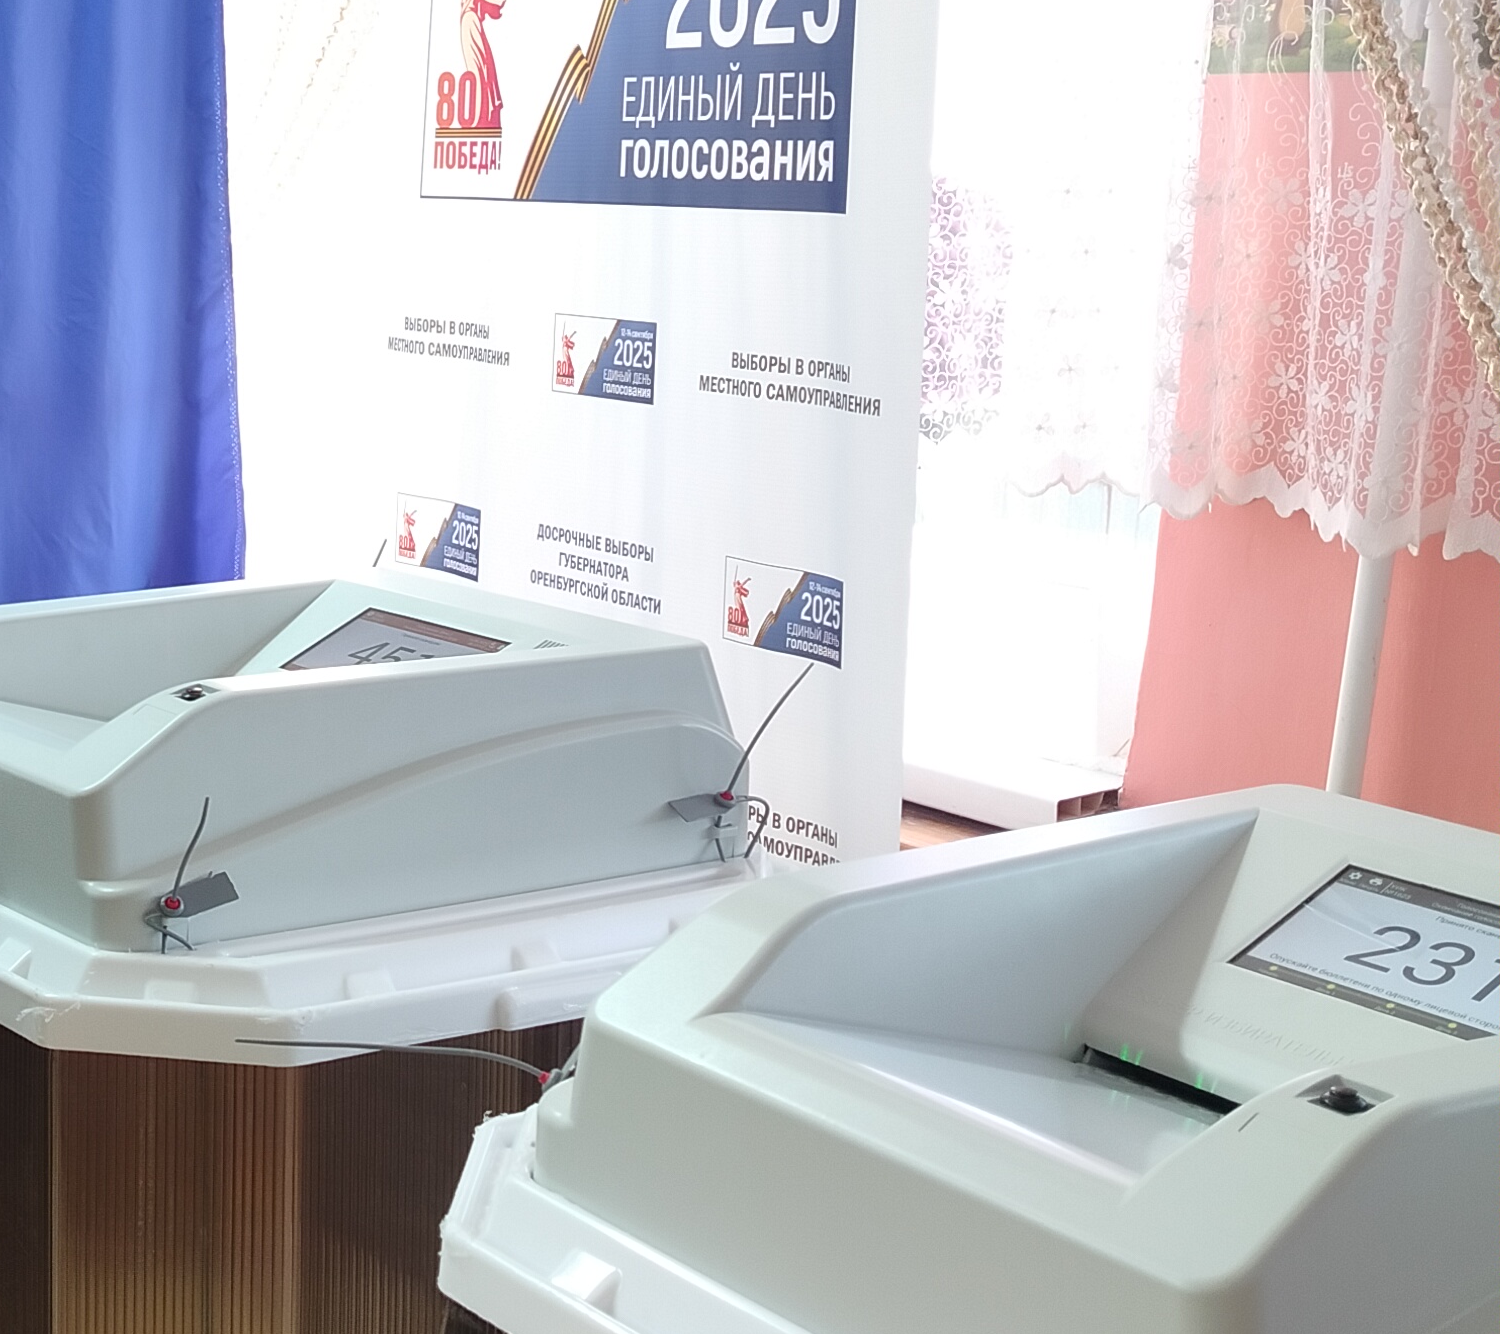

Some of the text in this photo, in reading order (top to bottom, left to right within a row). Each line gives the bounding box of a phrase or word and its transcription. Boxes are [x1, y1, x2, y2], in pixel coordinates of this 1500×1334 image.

[436, 71, 477, 128] 80
[622, 62, 836, 128] ЕДИНЫЙ ДЕНЬ
[433, 141, 502, 175] ПОБЕДА!
[405, 316, 490, 339] ВЫБОРЫ В ОРГАНЫ
[388, 336, 510, 366] МЕСТНОГО САМОУПРАВЛЕНИЯ
[613, 338, 653, 369] 2025
[731, 351, 851, 383] ВЫБОРЫ В ОРГАНЫ
[699, 374, 881, 417] МЕСТНОГО САМОУПРАВЛЕНИЯ
[452, 520, 479, 550] 2025
[537, 523, 654, 563] ДОСРОЧНЫЕ ВЫБОРЫ
[558, 552, 629, 582] ГУБЕРНАТОРА
[530, 569, 661, 615] ОРЕНБУРГСКОЙ ОБЛАСТИ
[728, 606, 740, 624] 80
[800, 592, 840, 630] 2025
[786, 622, 840, 648] ЕДИНЫЙ ДЕНЬ
[348, 642, 434, 665] 45
[772, 812, 781, 829] В
[786, 816, 838, 848] ОРГАНЫ
[1270, 953, 1318, 972] Опускайте
[1319, 968, 1370, 989] бюллетени
[1372, 986, 1384, 994] по
[1385, 990, 1422, 1006] одному
[1424, 1003, 1468, 1019] лицевой
